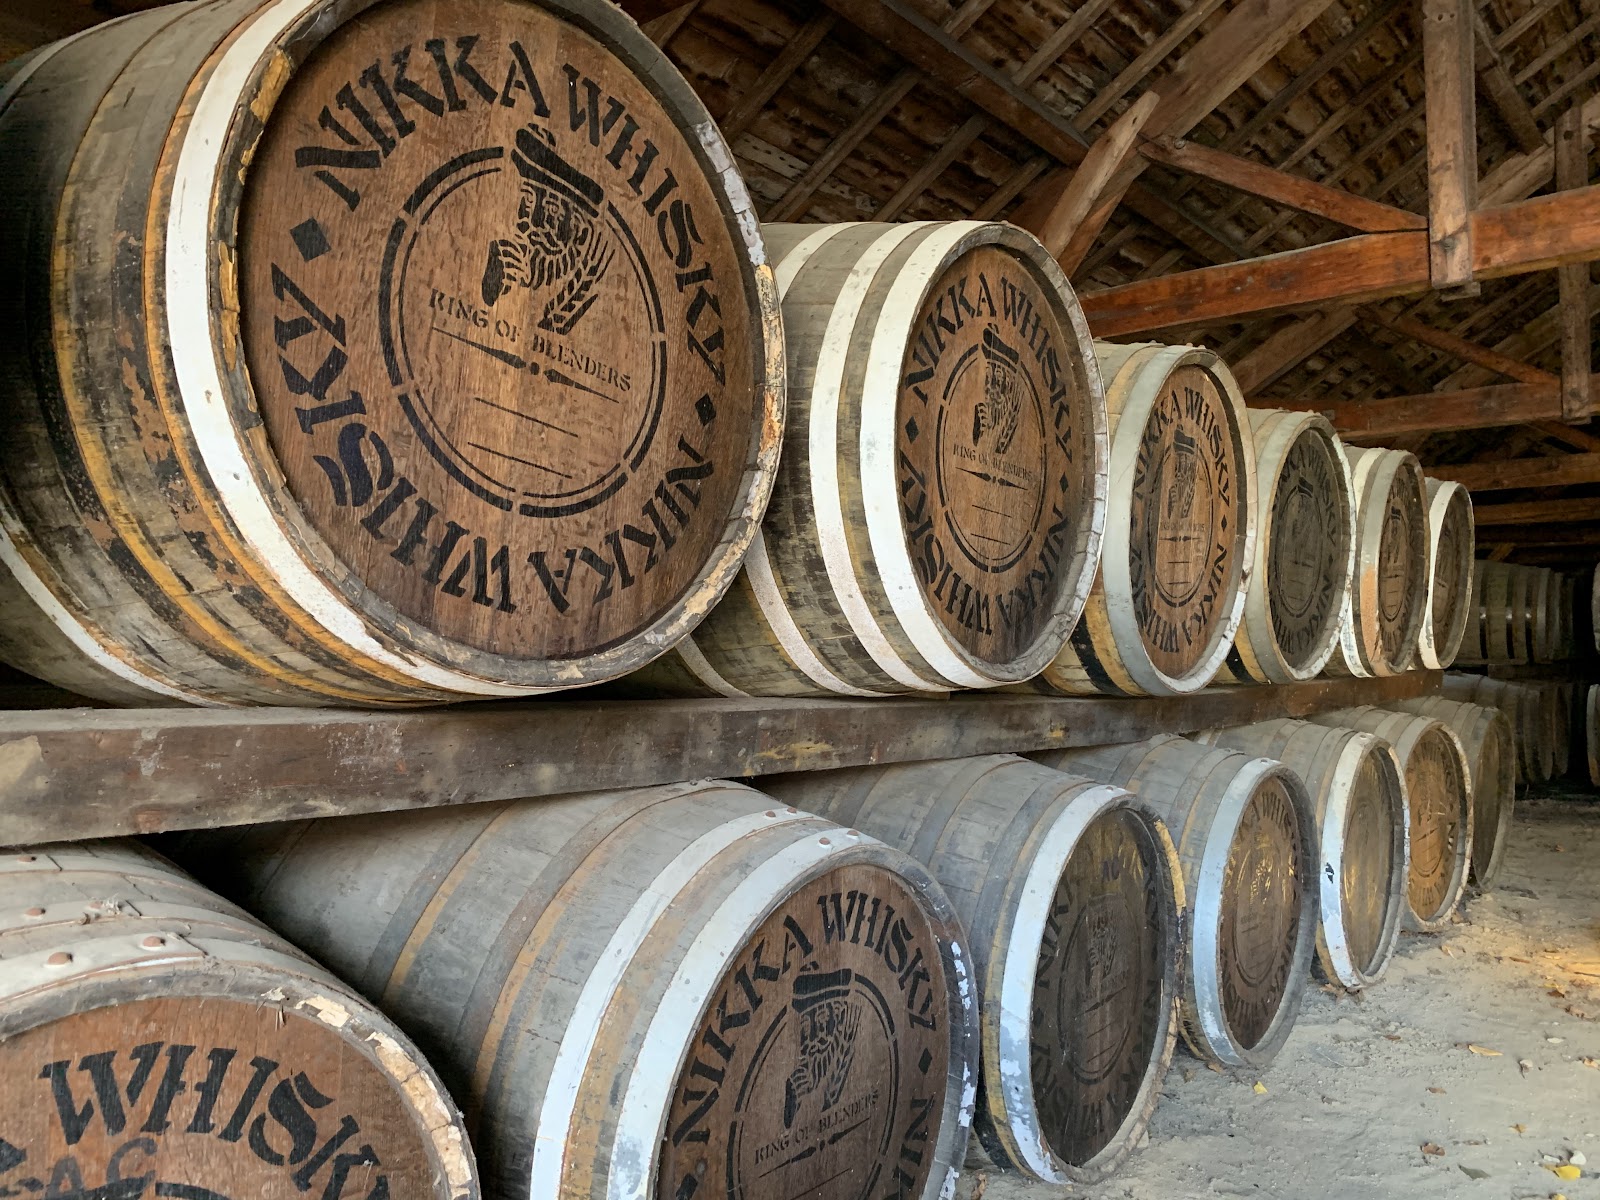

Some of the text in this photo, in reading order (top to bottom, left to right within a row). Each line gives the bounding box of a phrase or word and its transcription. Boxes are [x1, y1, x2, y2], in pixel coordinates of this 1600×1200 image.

[295, 34, 726, 387] NIKKA WHISKY
[428, 288, 631, 392] KING OF BLENDERS
[905, 271, 1073, 463] NIKKA WHISKY
[271, 262, 715, 614] NIKKA WHISKY
[1184, 386, 1230, 508] WHISKY
[672, 889, 937, 1148] NIKKA WHISKY
[755, 1134, 790, 1165] KING
